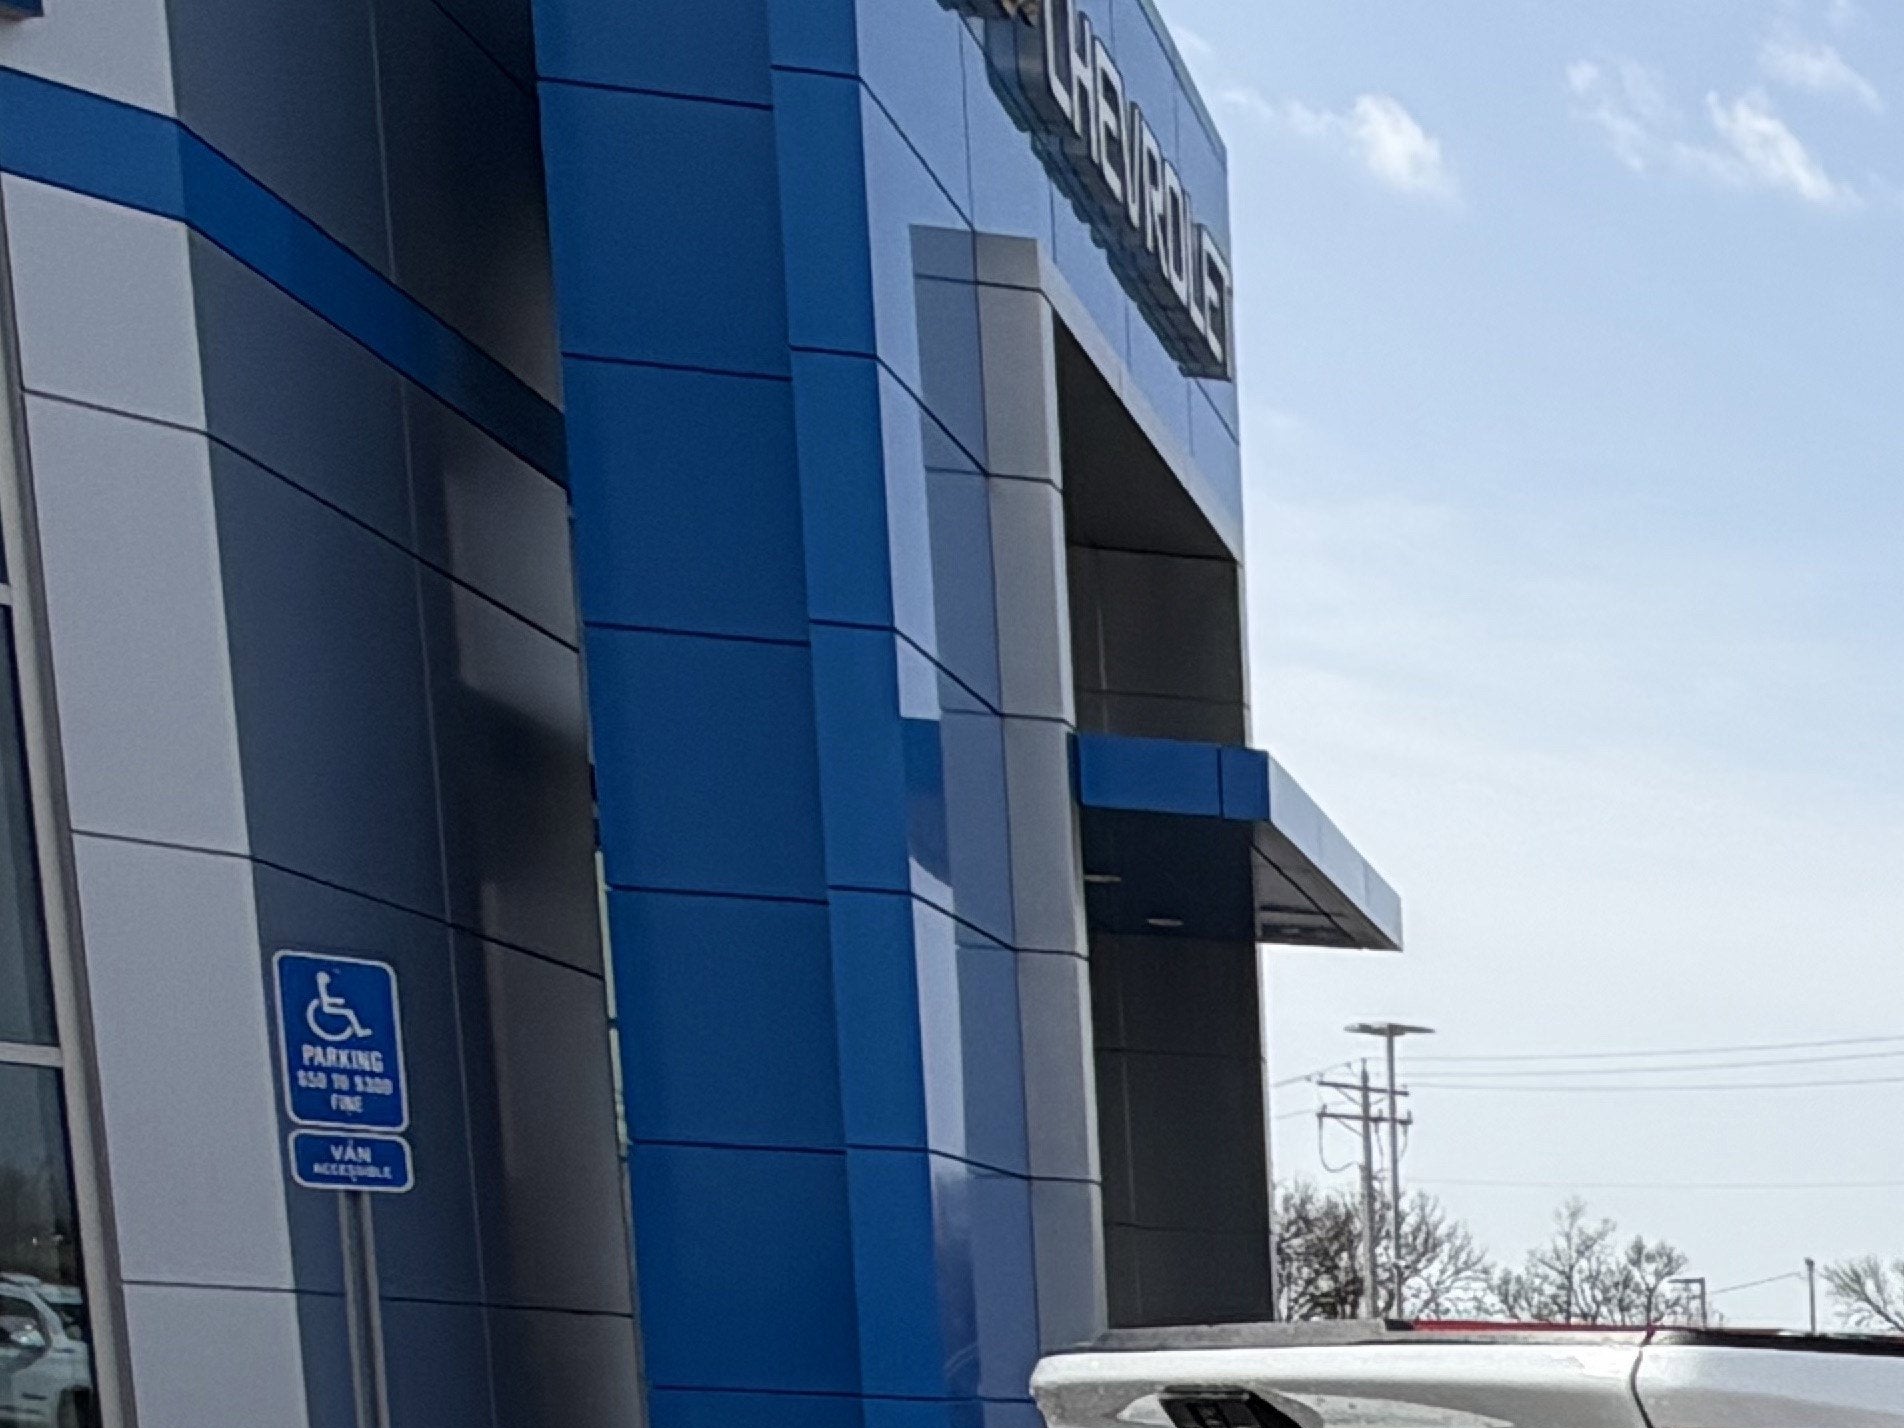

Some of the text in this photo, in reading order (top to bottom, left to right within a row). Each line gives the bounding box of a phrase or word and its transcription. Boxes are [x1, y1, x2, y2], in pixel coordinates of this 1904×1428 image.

[301, 1044, 384, 1073] PARKING
[331, 1073, 350, 1091] TO
[331, 1093, 363, 1112] FINE
[330, 1144, 371, 1163] VAN
[313, 1163, 392, 1180] ACCESSIBLE
